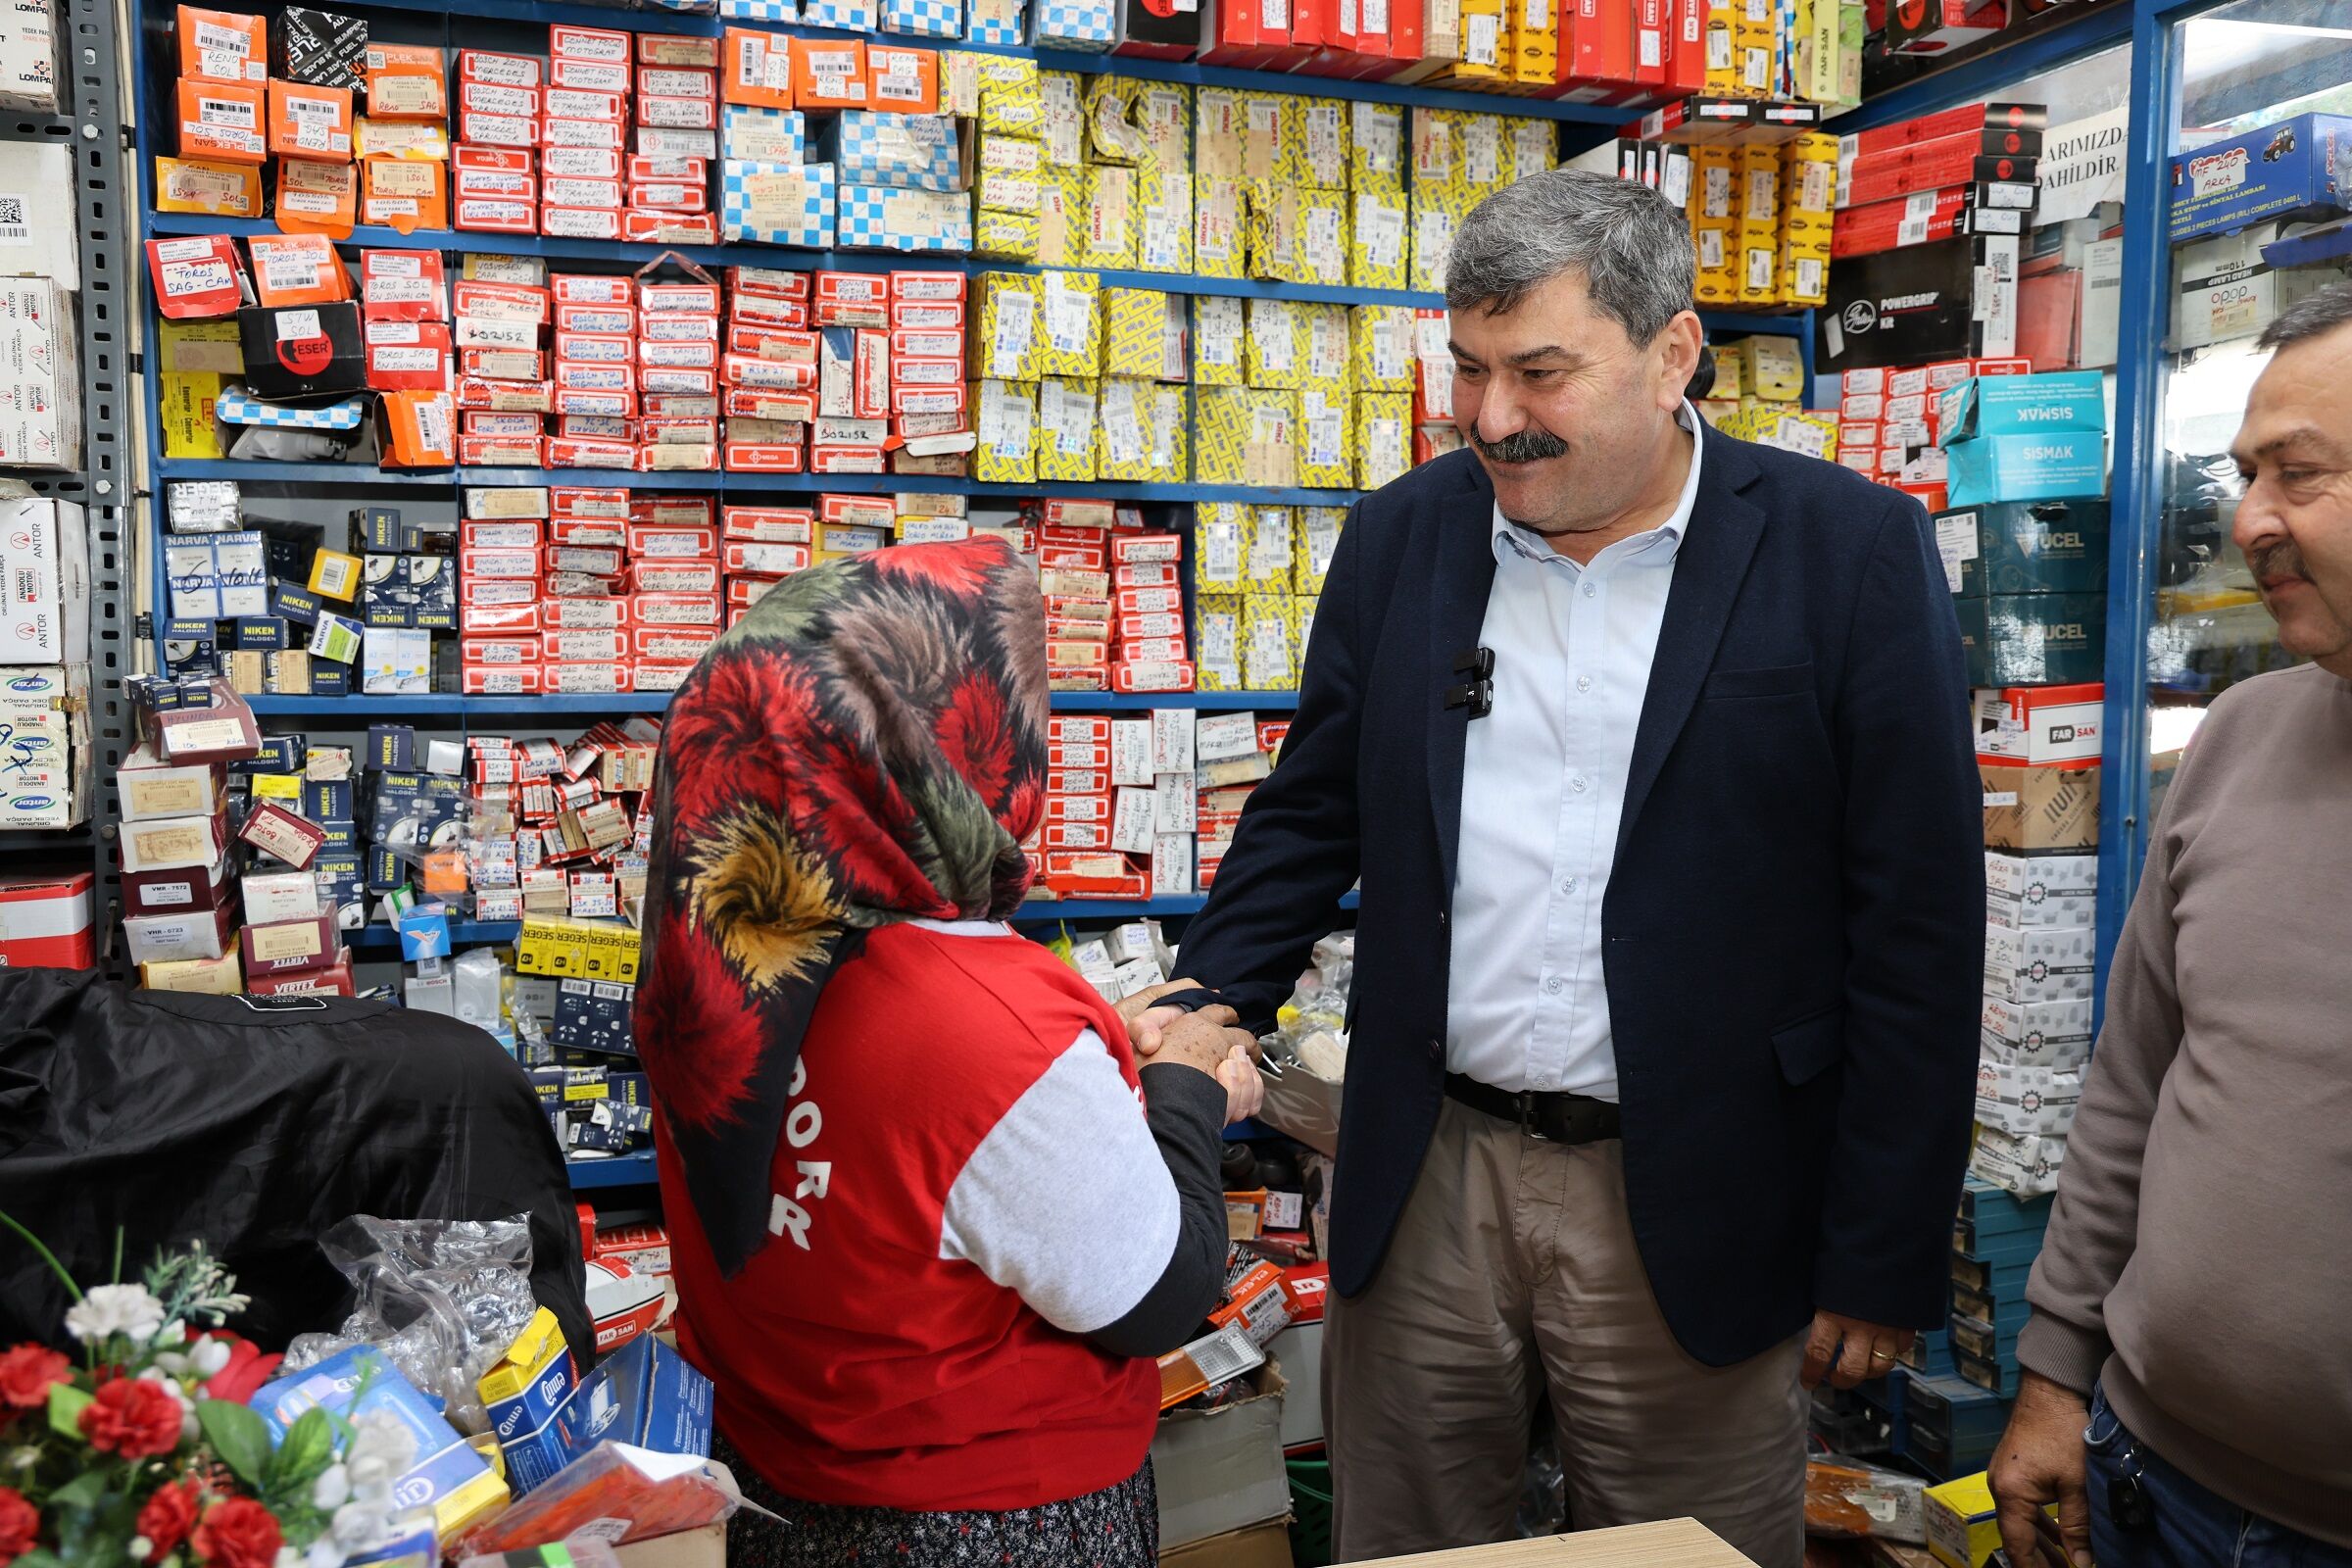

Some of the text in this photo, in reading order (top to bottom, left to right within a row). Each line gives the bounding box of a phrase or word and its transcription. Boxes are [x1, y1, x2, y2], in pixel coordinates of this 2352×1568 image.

[208, 53, 238, 63] RENO
[503, 58, 528, 69] 2013
[211, 67, 234, 77] SOL
[504, 89, 526, 98] 2013
[2037, 126, 2130, 166] ARIMIZD
[2217, 158, 2238, 171] 240
[2203, 174, 2231, 190] ARKA
[267, 251, 326, 264] TOROS SOL
[175, 268, 214, 279] TOROS
[2208, 269, 2252, 286] HEAD LAMP
[368, 280, 428, 290] TOROS SOL
[1880, 291, 1940, 312] POWERGRIP
[291, 325, 316, 336] SOL
[375, 349, 405, 359] TOROS
[2017, 408, 2074, 421] SISMAK
[2023, 445, 2074, 460] SISMAK
[376, 515, 385, 546] NIKEN
[168, 536, 209, 545] NARVA
[217, 534, 259, 543] NARVA
[280, 594, 314, 611] NIKEN
[371, 613, 405, 624] NIKEN
[417, 614, 450, 624] NIKEN
[38, 613, 47, 649] ANTOR
[244, 626, 275, 635] NIKEN
[316, 618, 329, 651] NARVA
[14, 678, 48, 690] antor
[2051, 726, 2096, 741] FAR SAN
[382, 736, 392, 765] NIKEN
[386, 775, 418, 786] NIKEN
[13, 797, 48, 809] antor
[320, 787, 330, 816] NIKEN
[321, 861, 355, 873] NIKEN
[384, 852, 394, 882] NIKEN
[522, 929, 555, 941] SEGER
[556, 931, 587, 943] SEGER
[590, 935, 621, 947] SEGER
[273, 956, 310, 968] VERTEX
[273, 979, 319, 995] VERTEX
[566, 1071, 604, 1083] NARVA
[599, 1325, 634, 1342] FAR SAN
